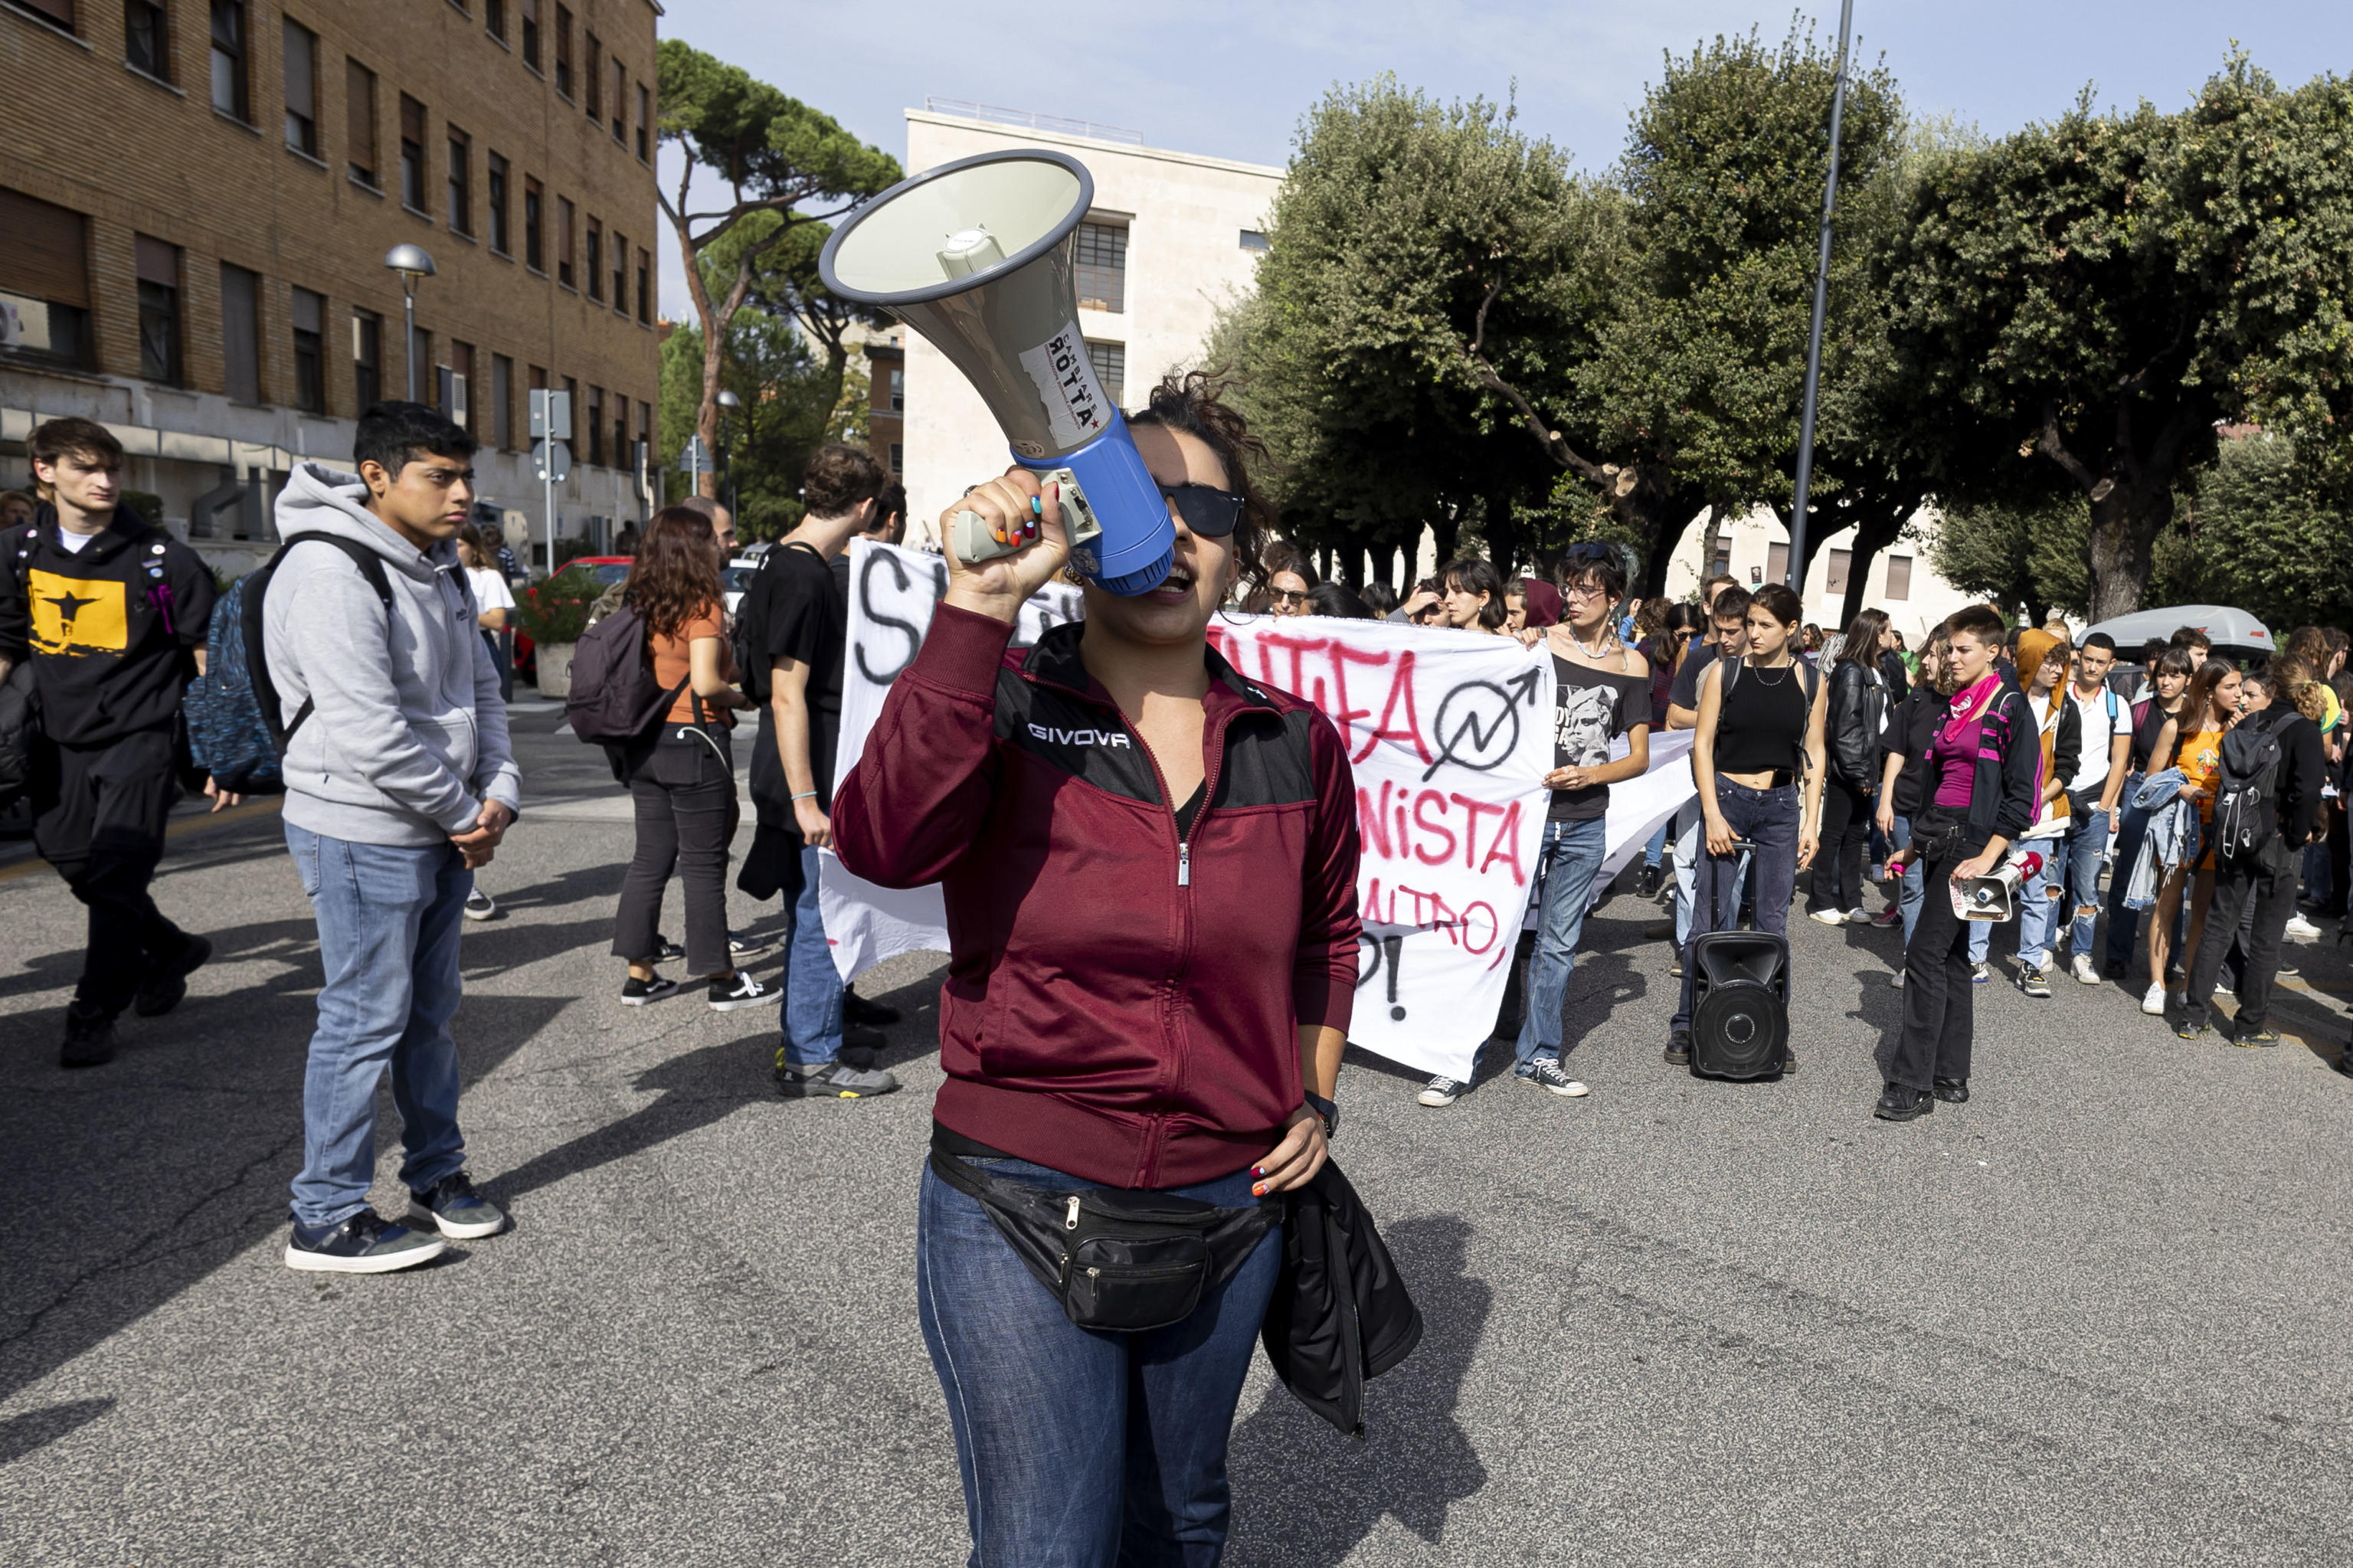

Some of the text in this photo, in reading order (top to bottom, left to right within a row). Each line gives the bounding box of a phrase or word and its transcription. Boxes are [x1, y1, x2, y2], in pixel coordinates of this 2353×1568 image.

[1062, 333, 1098, 413] CAMBIARE
[1027, 722, 1131, 749] GIVOVA
[1357, 780, 1524, 886] NiSTA
